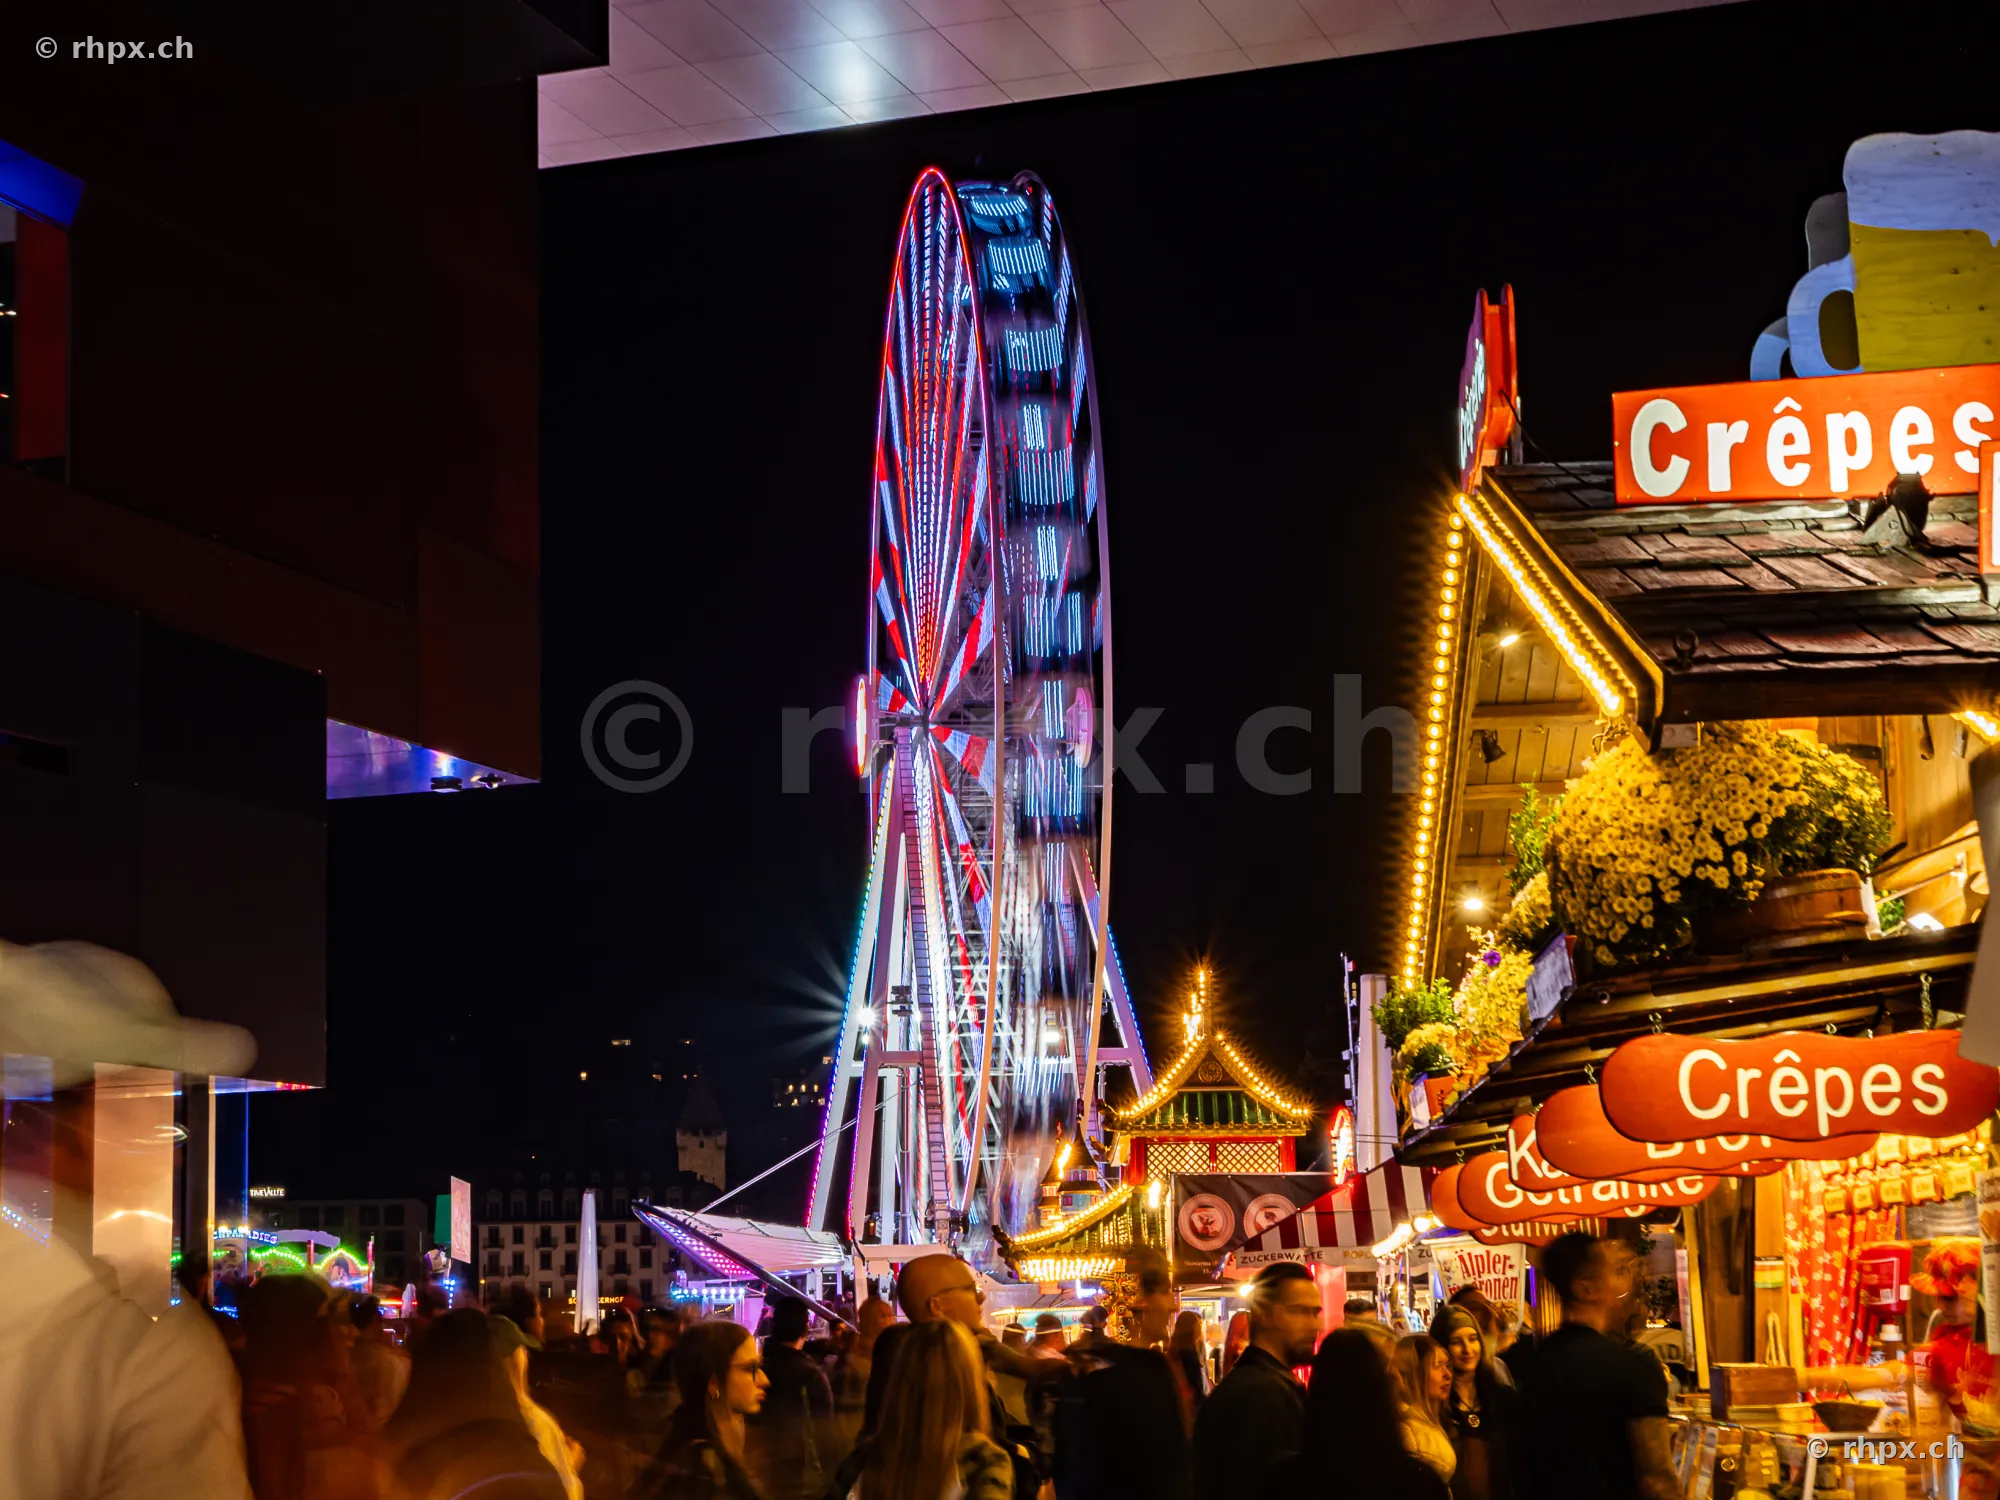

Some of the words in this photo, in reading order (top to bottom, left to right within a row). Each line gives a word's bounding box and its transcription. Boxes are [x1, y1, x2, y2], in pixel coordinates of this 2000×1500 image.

[1630, 396, 1995, 498] Crêpes
[1678, 1048, 1948, 1137] Crêpes
[1240, 1250, 1324, 1264] ZUCKERWATTE
[1454, 1249, 1515, 1280] Älpler-
[567, 1296, 625, 1305] SCERHOF
[1448, 1276, 1519, 1301] mronen
